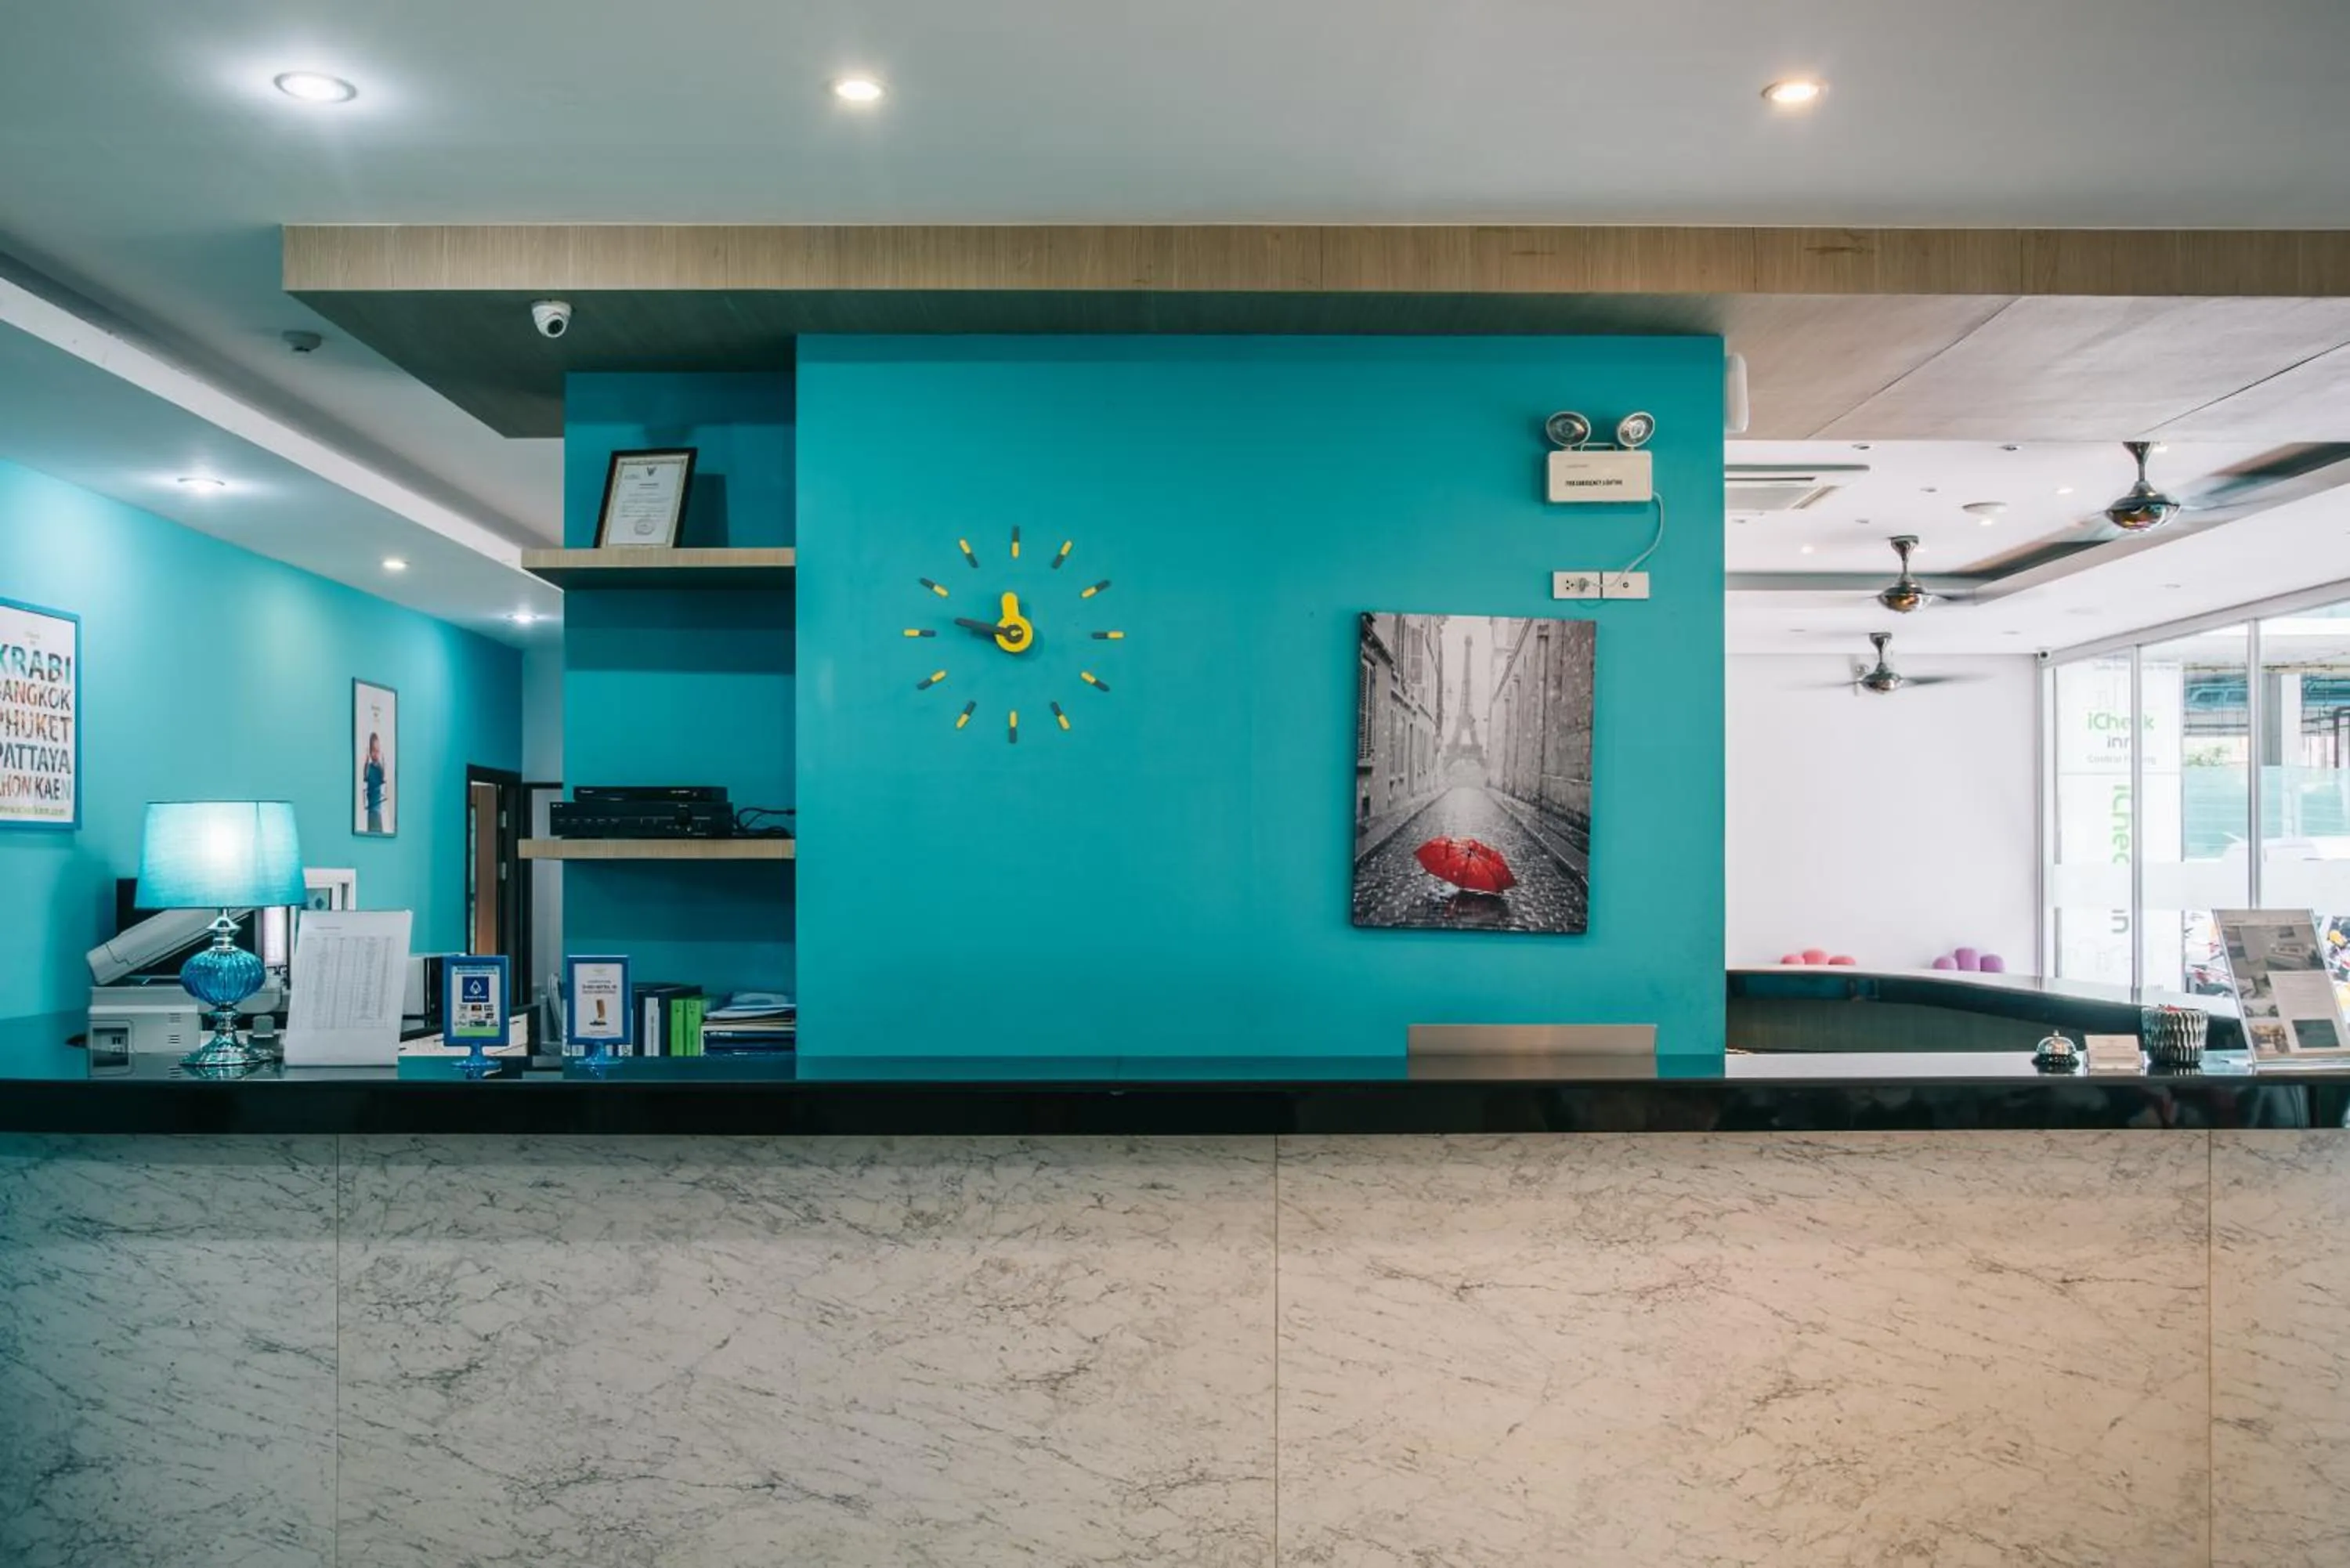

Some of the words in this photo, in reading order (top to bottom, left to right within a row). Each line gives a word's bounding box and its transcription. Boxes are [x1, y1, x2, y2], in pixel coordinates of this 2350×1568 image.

[0, 644, 71, 685] KRABI
[0, 678, 71, 711] ANGKOK
[2087, 711, 2154, 731] iChek
[0, 772, 31, 799] HON
[34, 775, 71, 802] KAEN
